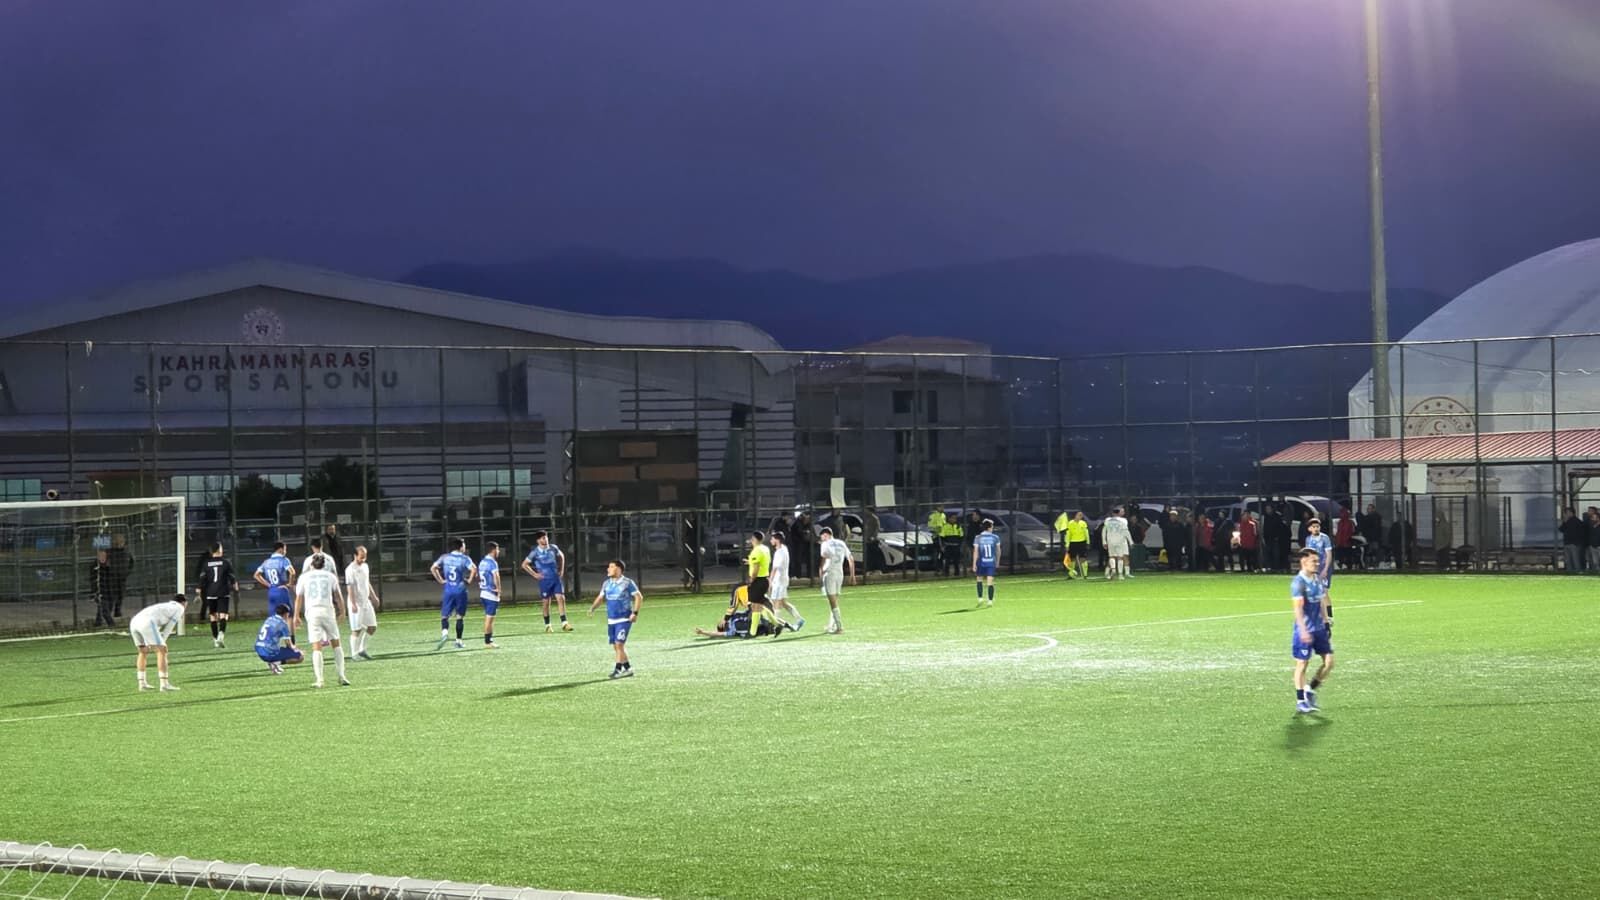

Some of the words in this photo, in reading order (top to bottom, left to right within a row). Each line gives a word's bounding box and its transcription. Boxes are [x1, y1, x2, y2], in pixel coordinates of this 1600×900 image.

[134, 374, 230, 394] SPOR
[984, 543, 992, 557] 11
[213, 566, 218, 583] 1
[267, 568, 280, 585] 18
[449, 566, 458, 582] 3
[259, 624, 270, 640] 5
